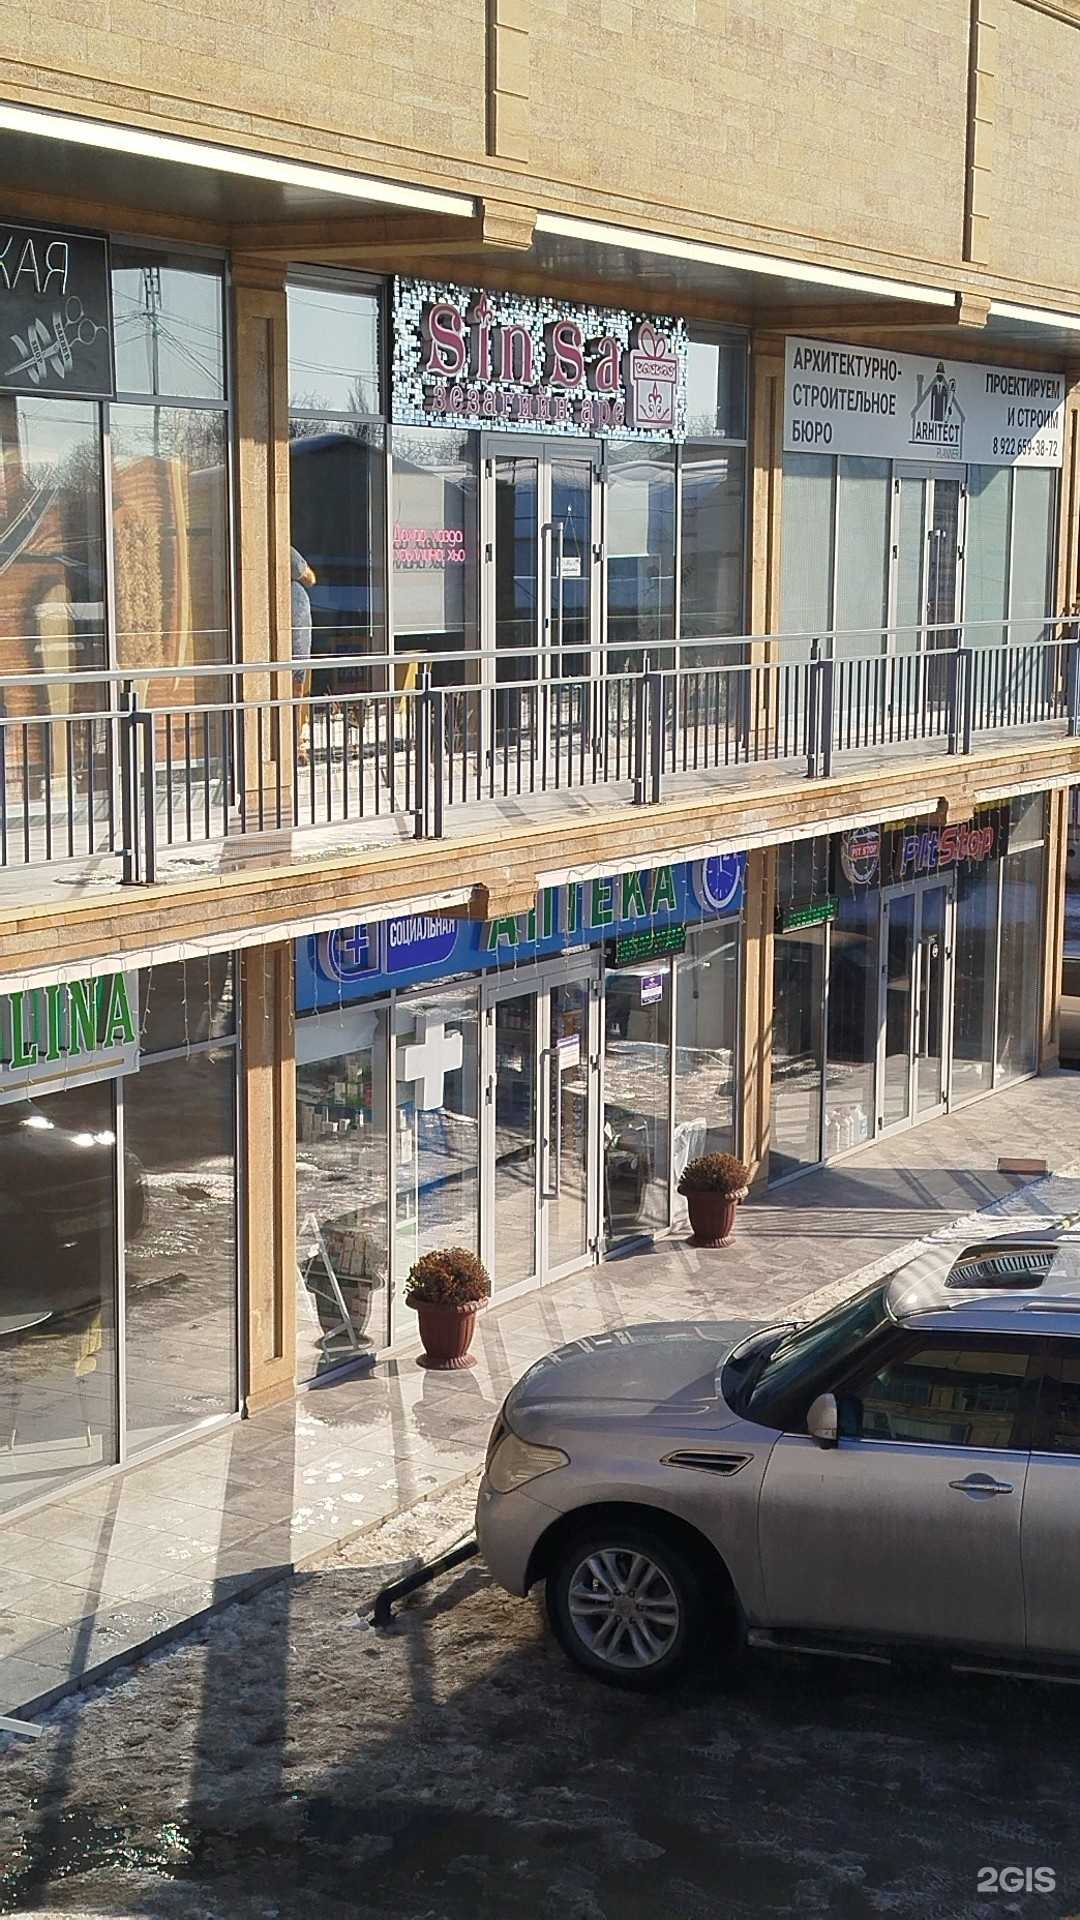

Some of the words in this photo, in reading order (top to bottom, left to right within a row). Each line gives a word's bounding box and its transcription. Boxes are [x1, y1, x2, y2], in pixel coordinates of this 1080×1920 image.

[793, 347, 902, 381] АРХИТЕКТУРНО-
[792, 383, 896, 415] СТРОИТЕЛЬНОЕ
[985, 373, 1060, 399] ПРОЕКТИРУЕМ
[792, 420, 832, 444] БЮРО
[1007, 407, 1015, 427] И
[1017, 407, 1059, 430] СТРОИМ
[487, 864, 678, 953] АПТЕКА
[390, 916, 455, 947] СОЦИАЛЬНАЯ
